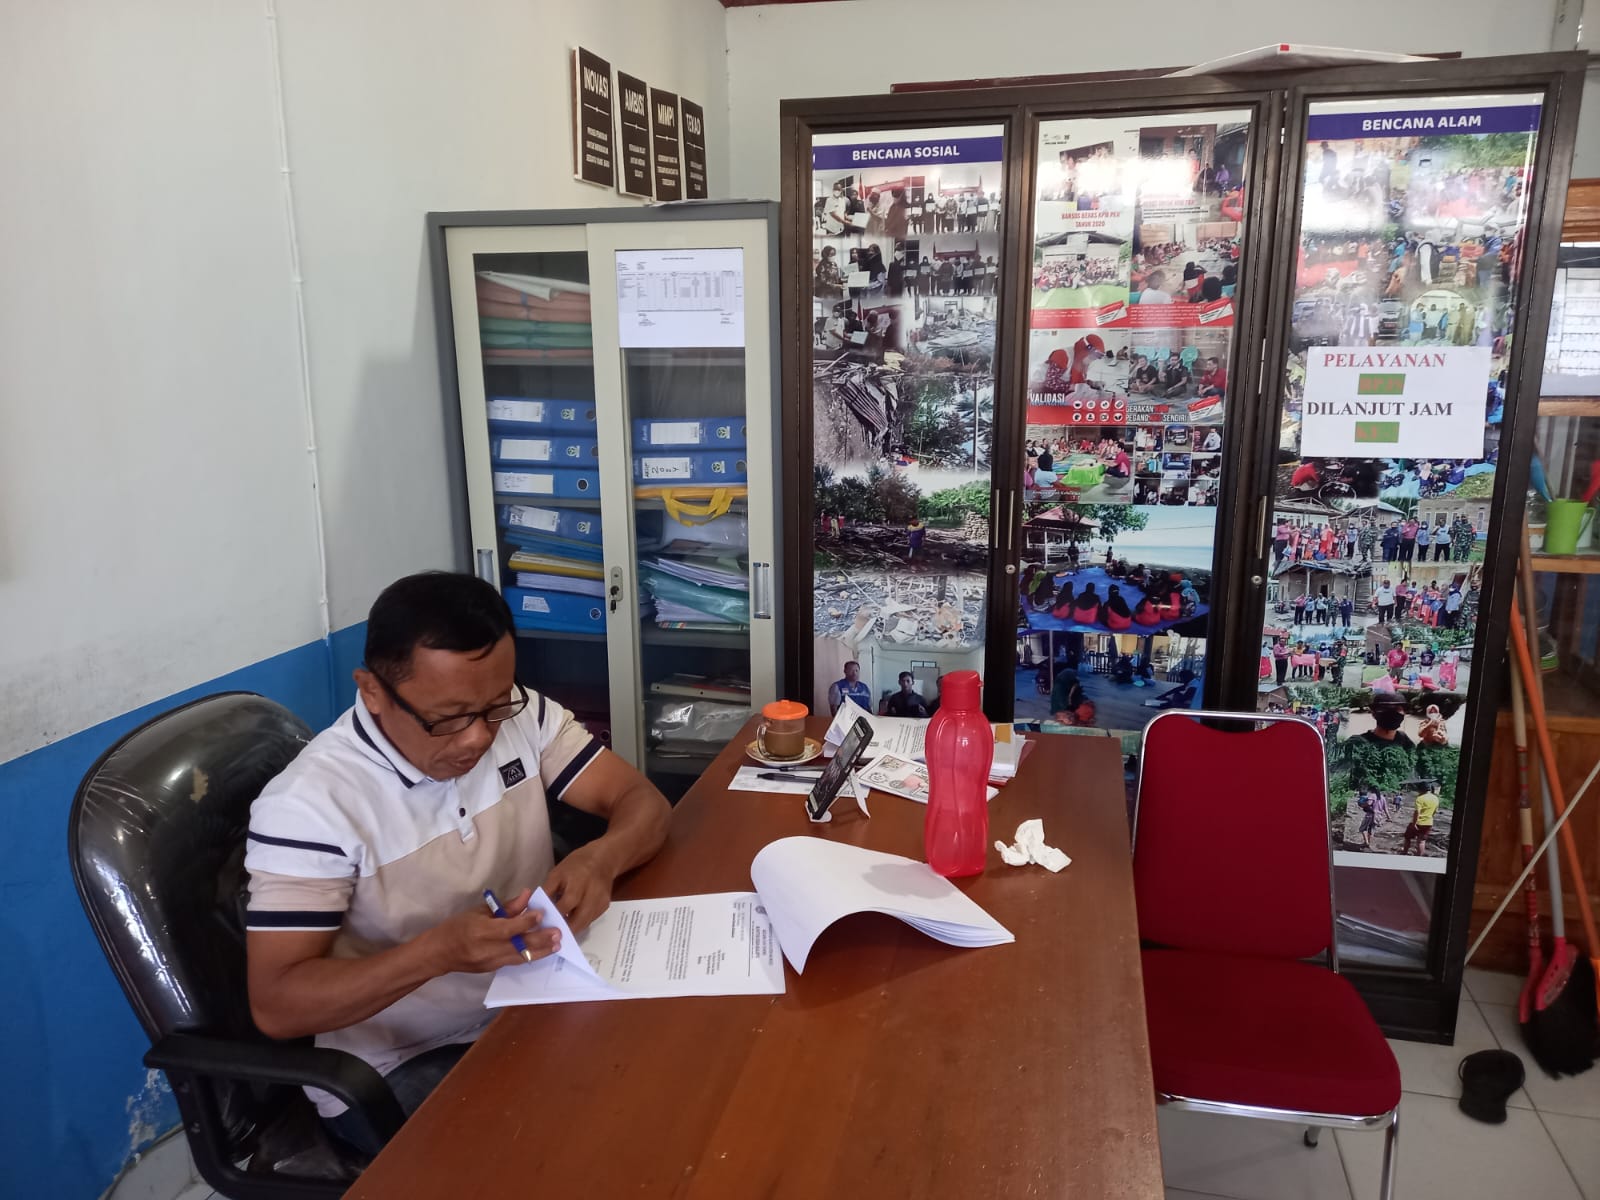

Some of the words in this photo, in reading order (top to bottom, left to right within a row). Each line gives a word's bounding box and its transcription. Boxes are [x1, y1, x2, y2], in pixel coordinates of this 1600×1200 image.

[583, 66, 609, 99] INOVASI
[657, 103, 675, 128] MIMPI
[1362, 117, 1434, 131] BENCANA
[1437, 115, 1482, 129] ALAM
[852, 147, 911, 161] BENCANA
[914, 145, 960, 158] SOSIAL
[1323, 353, 1447, 367] PELAYANAN
[1029, 393, 1065, 404] VALIDASI
[1126, 405, 1154, 413] GERAKAN
[1306, 401, 1405, 416] DILANJUT
[1409, 402, 1453, 416] JAM
[1163, 414, 1187, 422] SENDIRI
